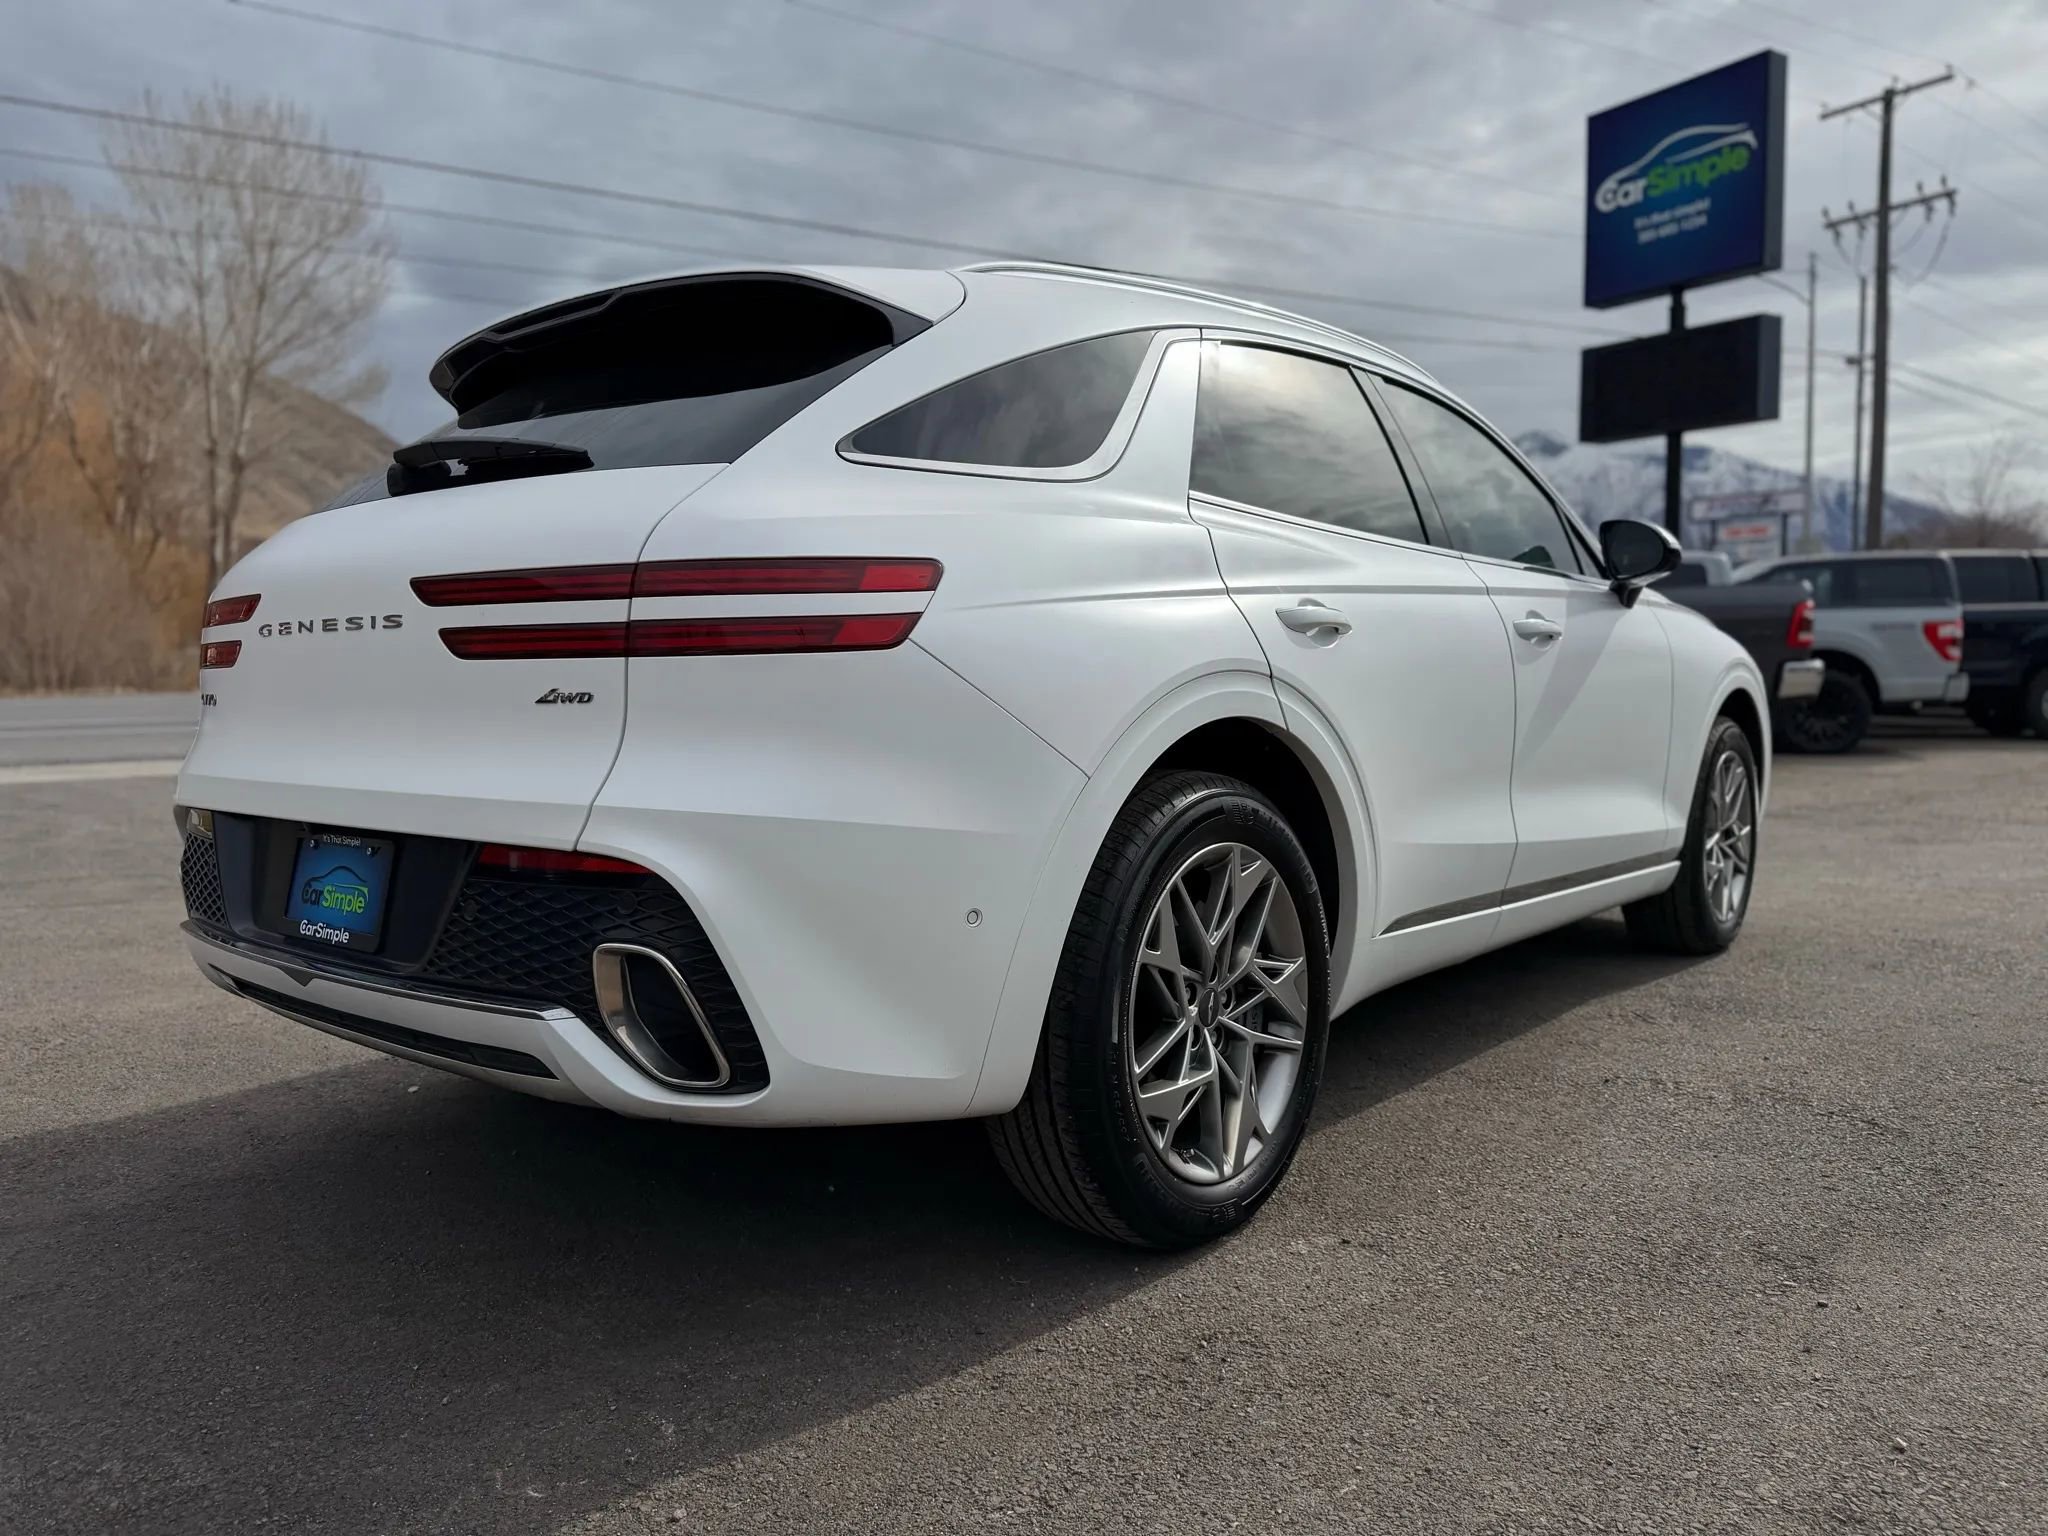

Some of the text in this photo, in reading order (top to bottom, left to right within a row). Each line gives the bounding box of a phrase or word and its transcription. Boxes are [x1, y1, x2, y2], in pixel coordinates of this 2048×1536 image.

[1595, 146, 1749, 213] CarSimple
[258, 614, 403, 638] GENESIS
[302, 883, 366, 916] CarSimple
[300, 919, 350, 944] CarSimple
